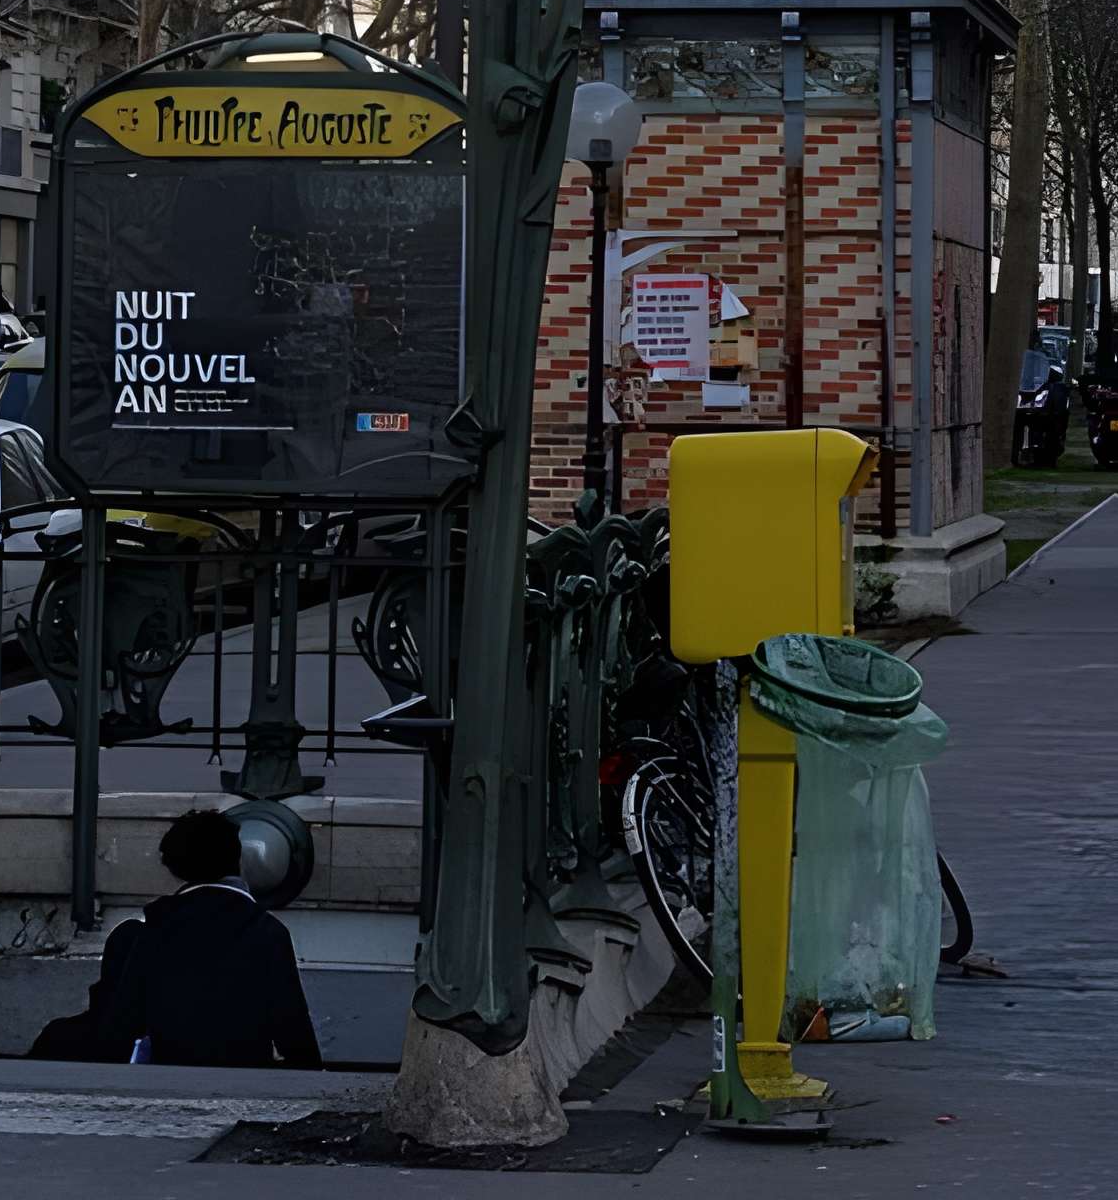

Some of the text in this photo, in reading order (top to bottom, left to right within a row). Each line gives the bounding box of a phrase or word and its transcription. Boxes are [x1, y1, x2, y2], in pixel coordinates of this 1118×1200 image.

[278, 101, 392, 149] AUGUSTE
[115, 290, 196, 320] NUIT
[115, 322, 163, 351] DU
[114, 354, 256, 383] NOUVEL
[114, 384, 167, 414] AN
